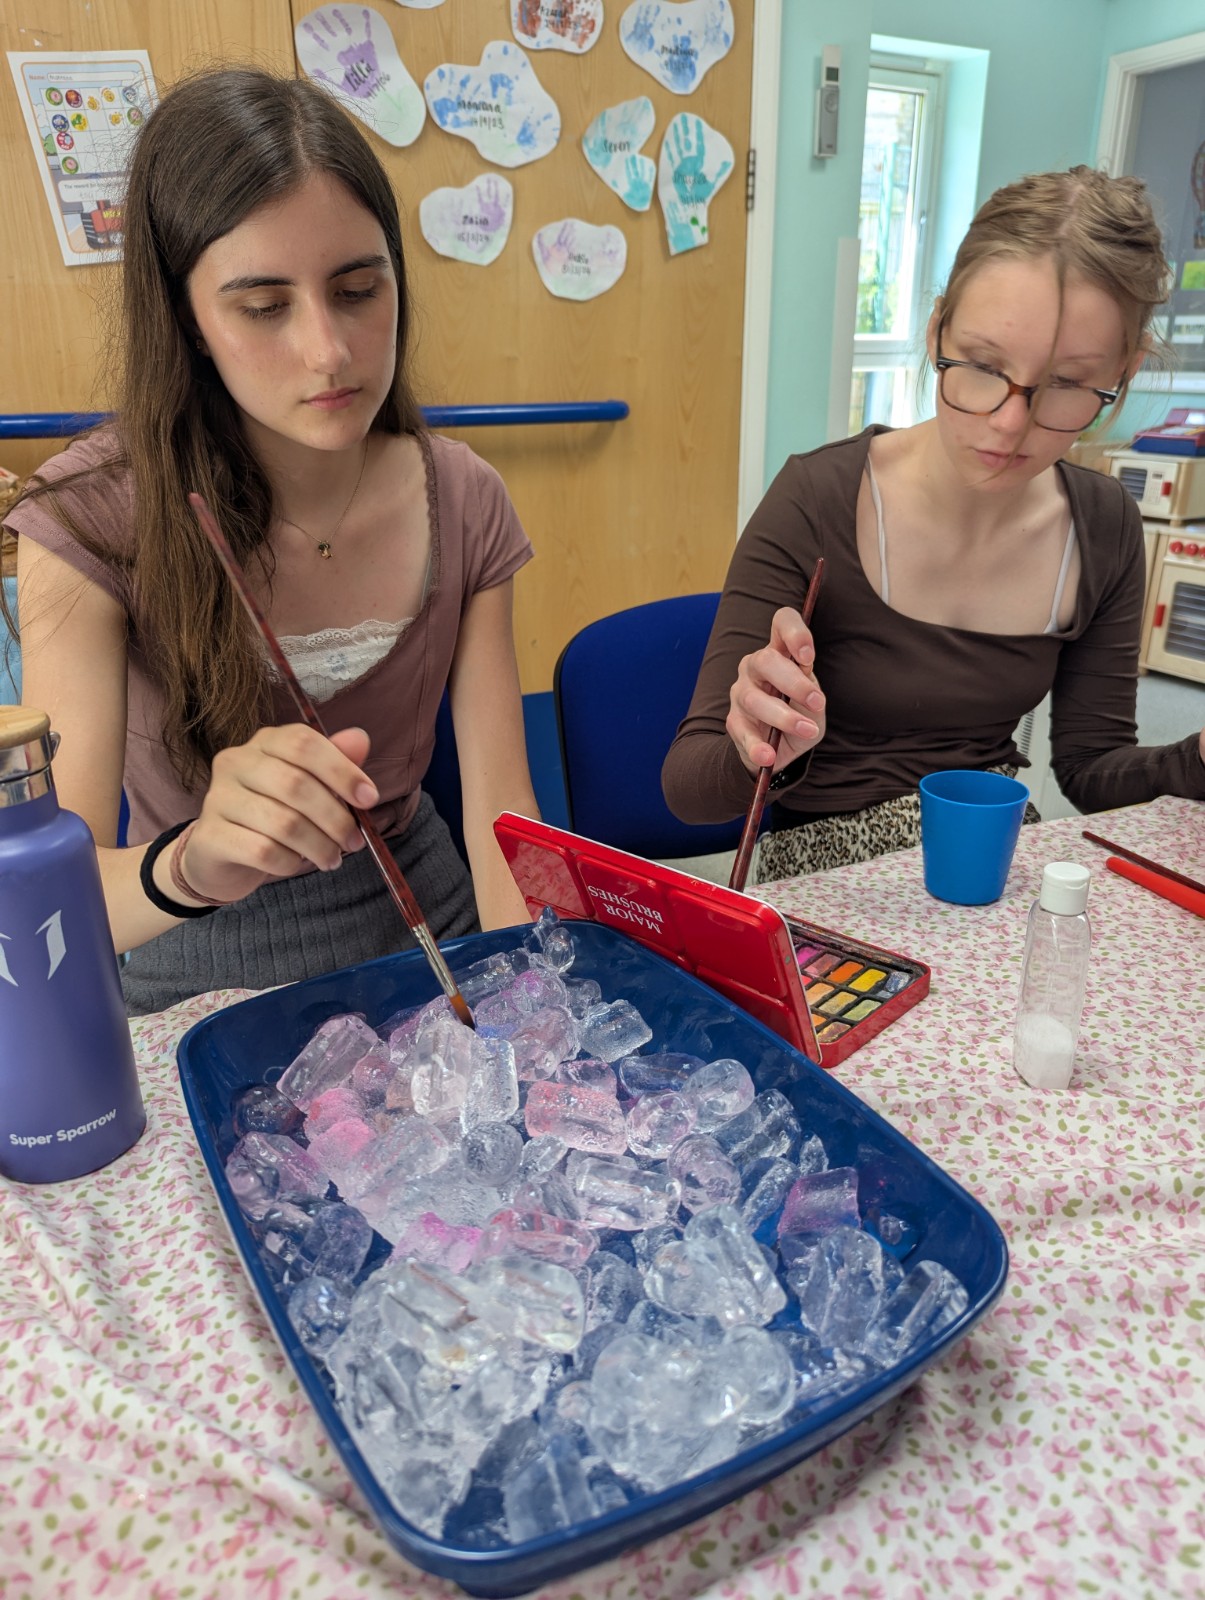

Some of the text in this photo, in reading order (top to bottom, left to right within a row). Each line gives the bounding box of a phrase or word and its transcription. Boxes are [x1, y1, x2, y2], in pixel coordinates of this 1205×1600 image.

[587, 885, 664, 923] BRUSHES
[603, 903, 662, 934] MAJOR
[9, 1108, 117, 1148] Super Sparrow
